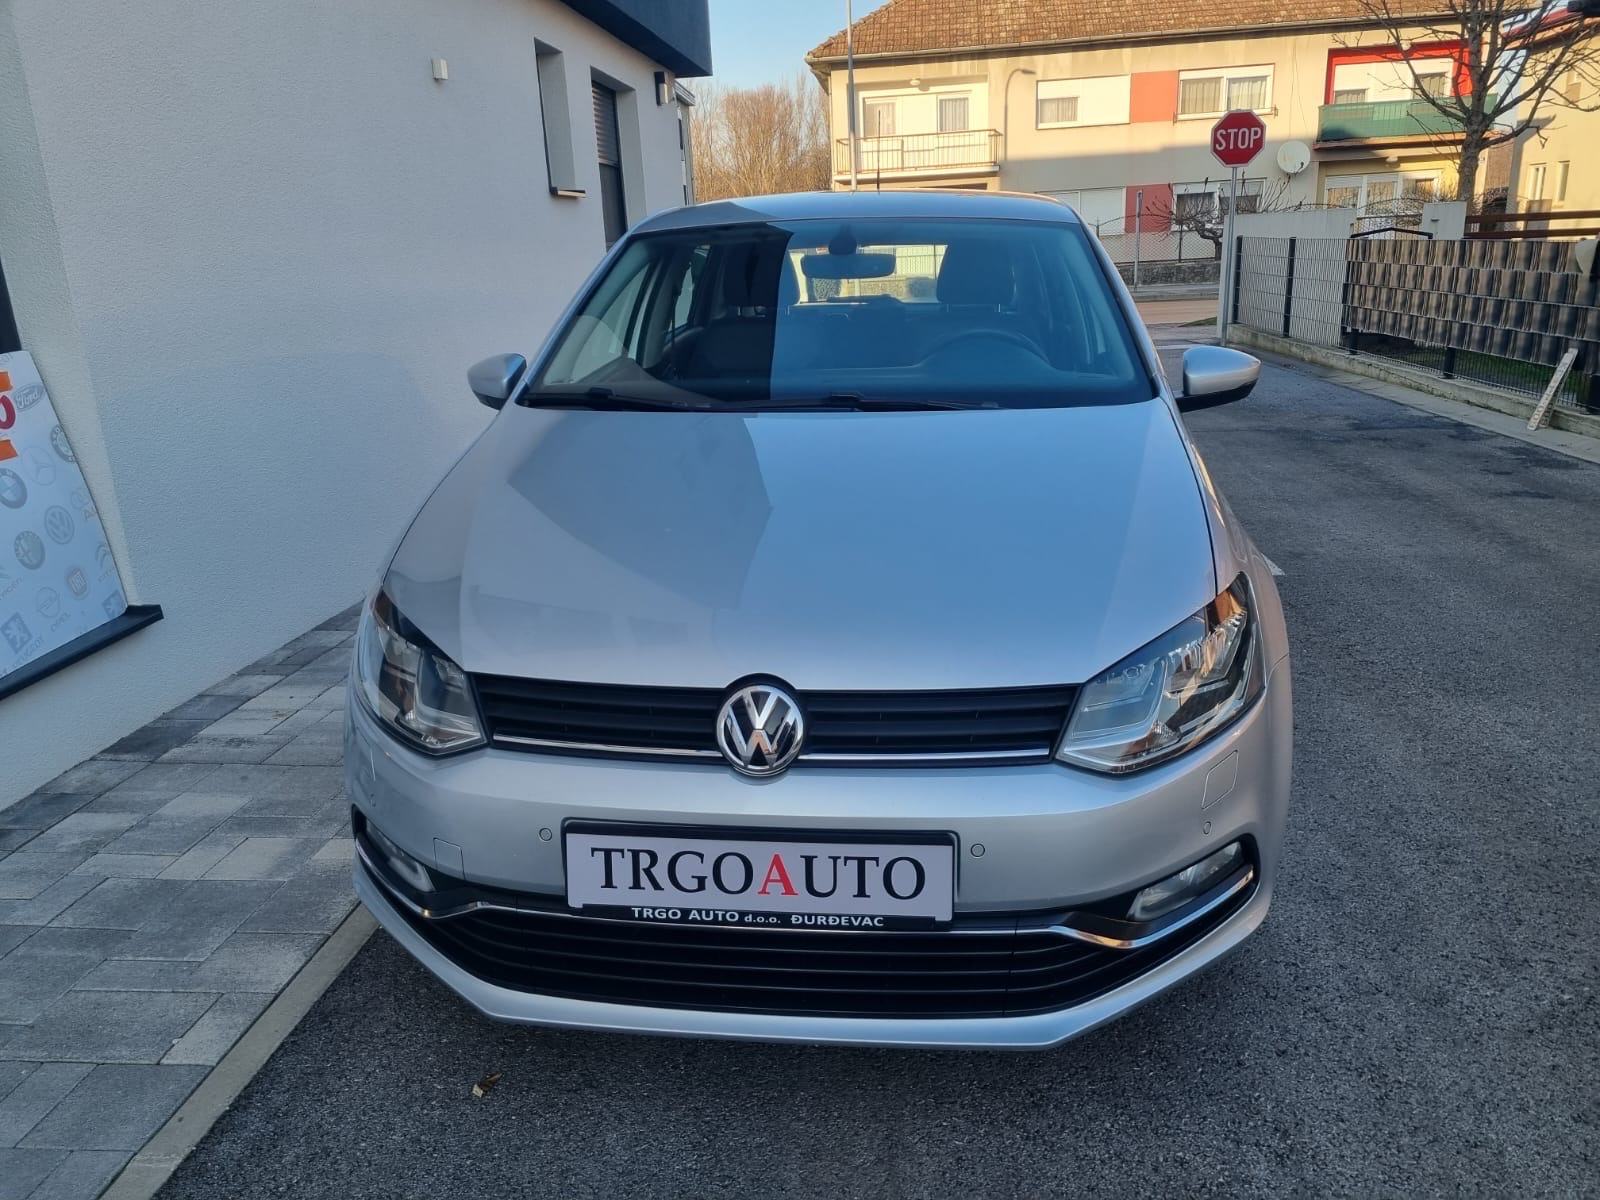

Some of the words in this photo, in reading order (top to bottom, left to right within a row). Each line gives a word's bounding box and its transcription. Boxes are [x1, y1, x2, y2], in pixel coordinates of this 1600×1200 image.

[1215, 127, 1262, 151] STOP
[15, 387, 40, 410] Ford
[590, 846, 926, 901] TRGOAUTO
[631, 907, 682, 920] TRGO
[688, 909, 740, 922] AUTO
[744, 912, 782, 924] d.o.o.
[790, 914, 885, 927] ĐURĐEVAC
